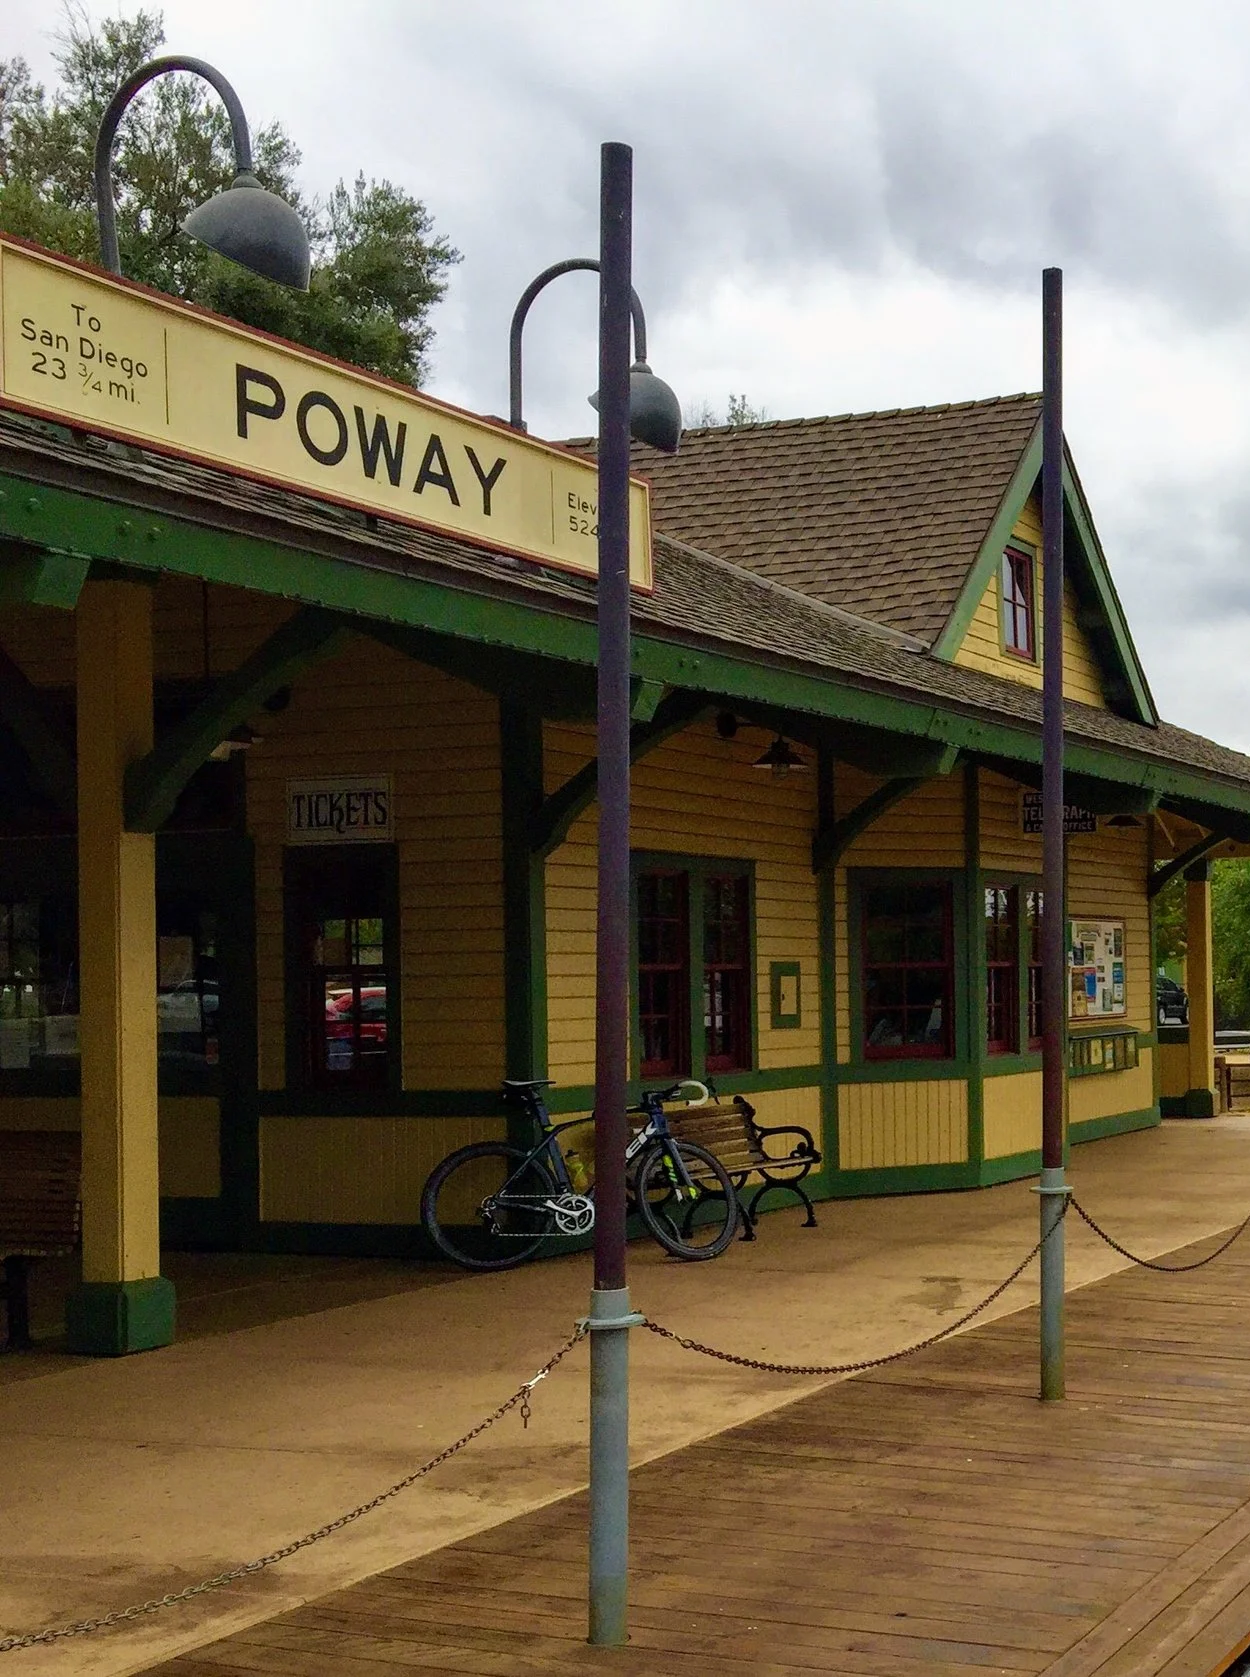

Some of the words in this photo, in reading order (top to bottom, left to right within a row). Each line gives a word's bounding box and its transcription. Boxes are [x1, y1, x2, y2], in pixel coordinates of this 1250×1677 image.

[71, 303, 101, 332] To
[20, 318, 69, 352] San
[80, 337, 148, 379] Diego
[31, 351, 67, 380] 23
[236, 363, 507, 516] POWAY
[292, 790, 388, 833] TICKETS
[1063, 821, 1093, 832] OFFICE
